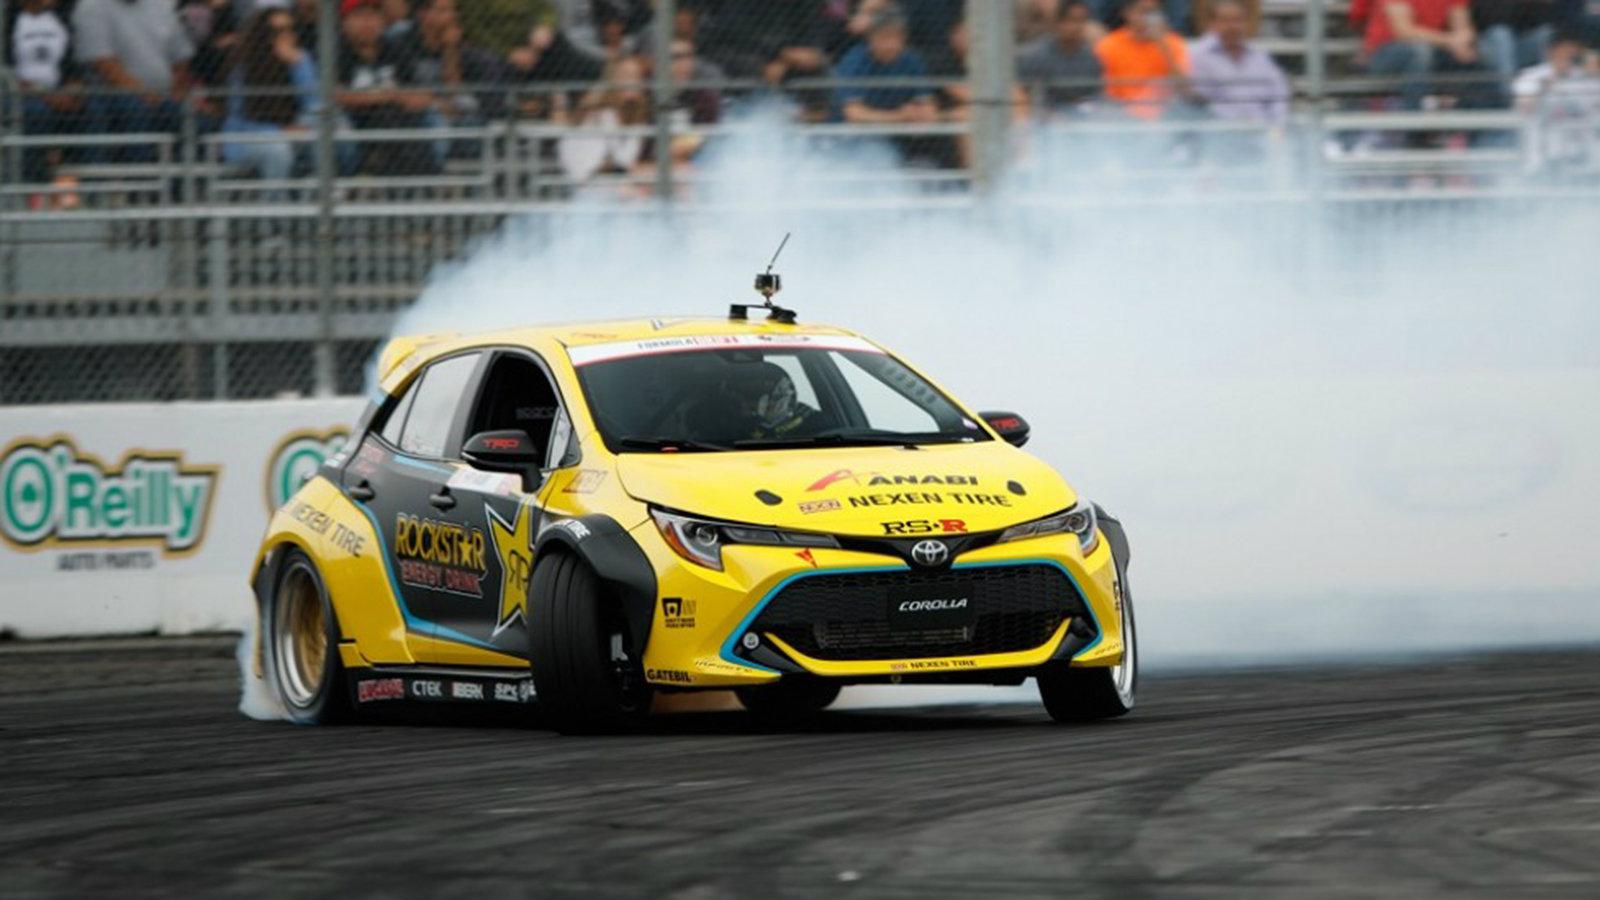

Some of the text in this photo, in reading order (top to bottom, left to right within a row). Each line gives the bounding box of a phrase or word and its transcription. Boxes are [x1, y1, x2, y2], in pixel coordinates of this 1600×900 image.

[483, 438, 519, 450] TRD
[868, 475, 978, 486] ANABI
[5, 453, 201, 539] O'Reilly
[849, 493, 1012, 508] NEXEN TIRE
[331, 522, 365, 558] TIRE
[899, 598, 968, 611] COROLLA
[646, 668, 692, 683] GATEBIL
[412, 681, 442, 697] CTEK
